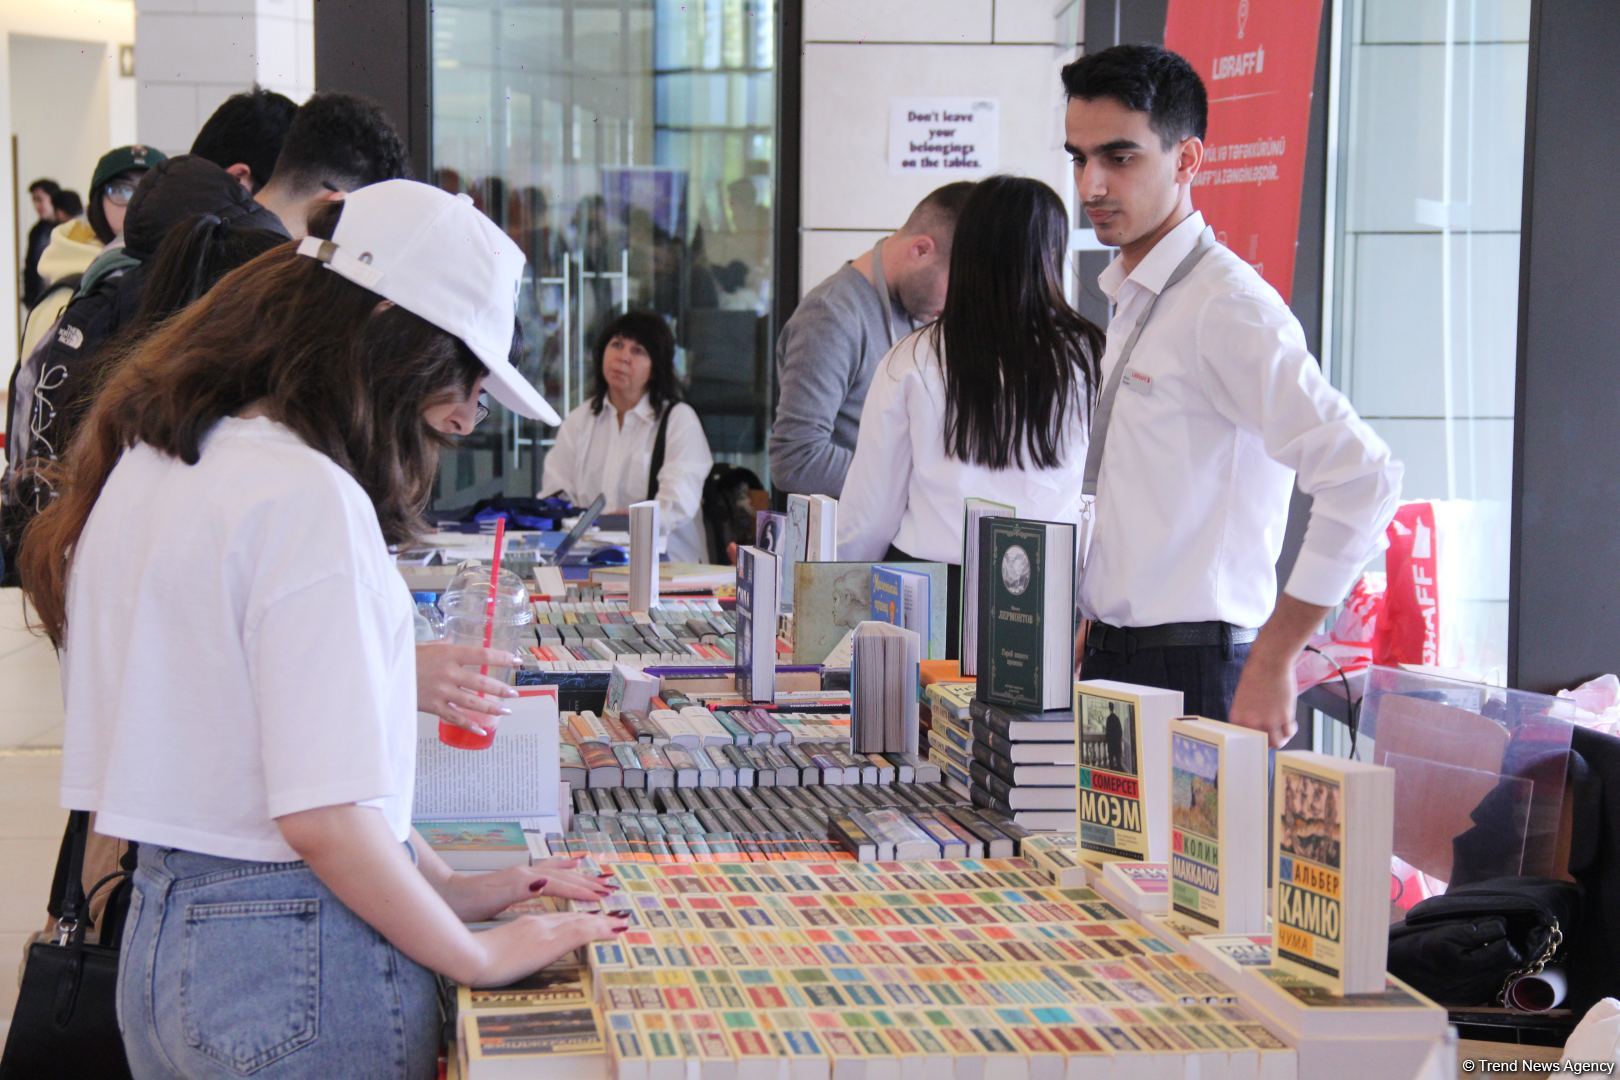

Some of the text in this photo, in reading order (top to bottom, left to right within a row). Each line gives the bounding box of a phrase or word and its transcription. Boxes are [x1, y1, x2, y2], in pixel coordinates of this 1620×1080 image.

[1212, 53, 1256, 80] LIBRAFF
[907, 111, 974, 122] Don't leave
[909, 141, 975, 155] belongings
[928, 129, 956, 140] your
[902, 157, 982, 168] on the tables.
[998, 610, 1034, 624] ЛЕРМОНТОВ
[1092, 773, 1138, 796] СОМЕРСЕТ
[1081, 790, 1141, 832] МОЭМ
[1184, 836, 1218, 866] КОЛИН
[1173, 857, 1218, 893] МАККАЛОУ
[1294, 863, 1340, 895] АЛЬБЕР
[1279, 884, 1340, 940] КАМЮ
[1279, 926, 1308, 953] ЧУМА
